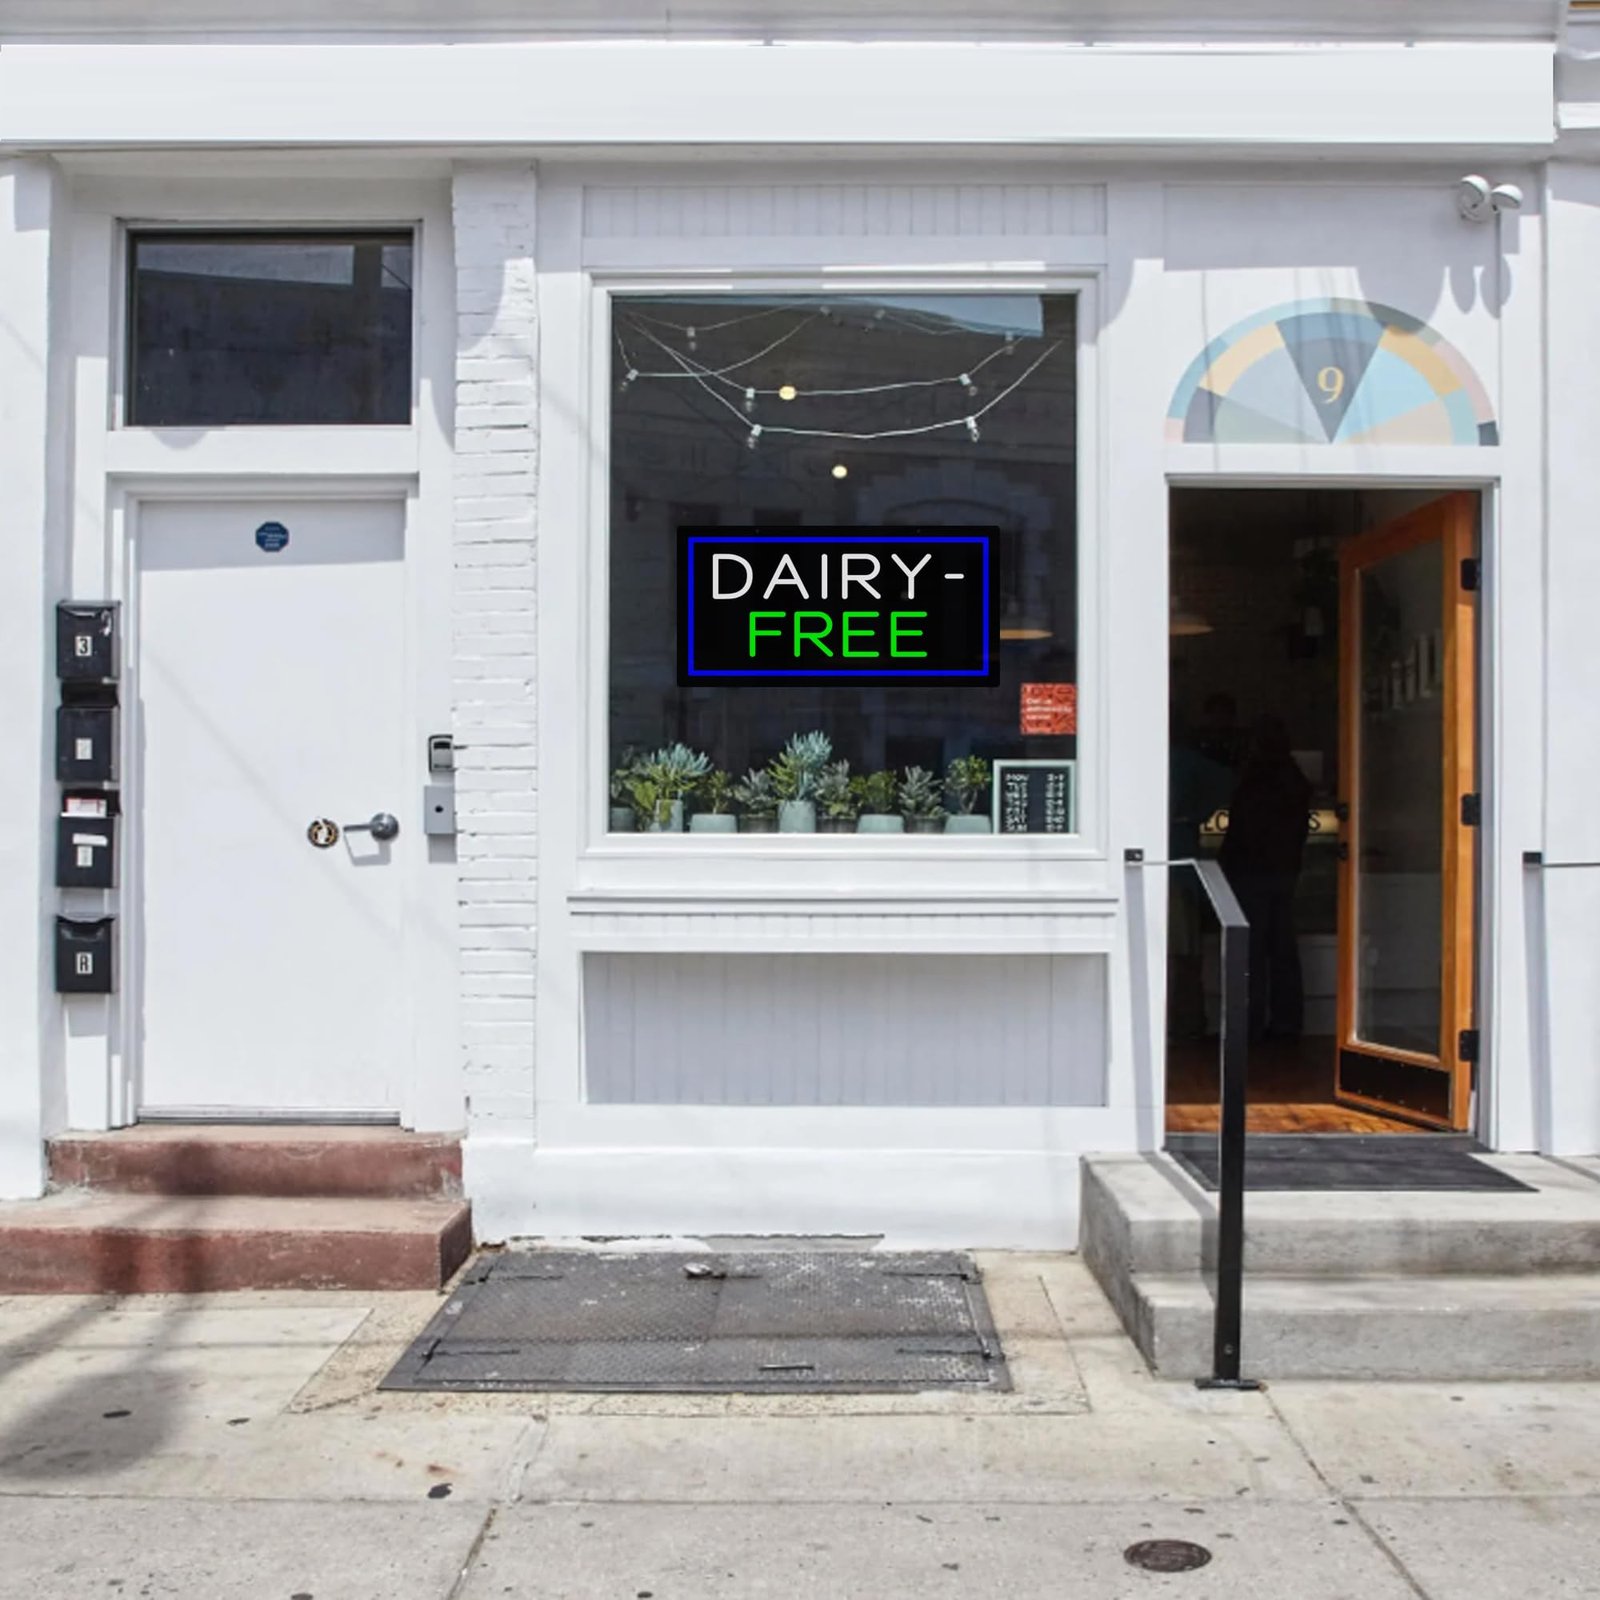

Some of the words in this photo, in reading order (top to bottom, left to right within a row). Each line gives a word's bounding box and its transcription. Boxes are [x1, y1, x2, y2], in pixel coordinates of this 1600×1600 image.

[1317, 366, 1344, 404] 9
[712, 553, 965, 600] DAIRY-
[79, 638, 88, 654] 3
[749, 611, 928, 658] FREE
